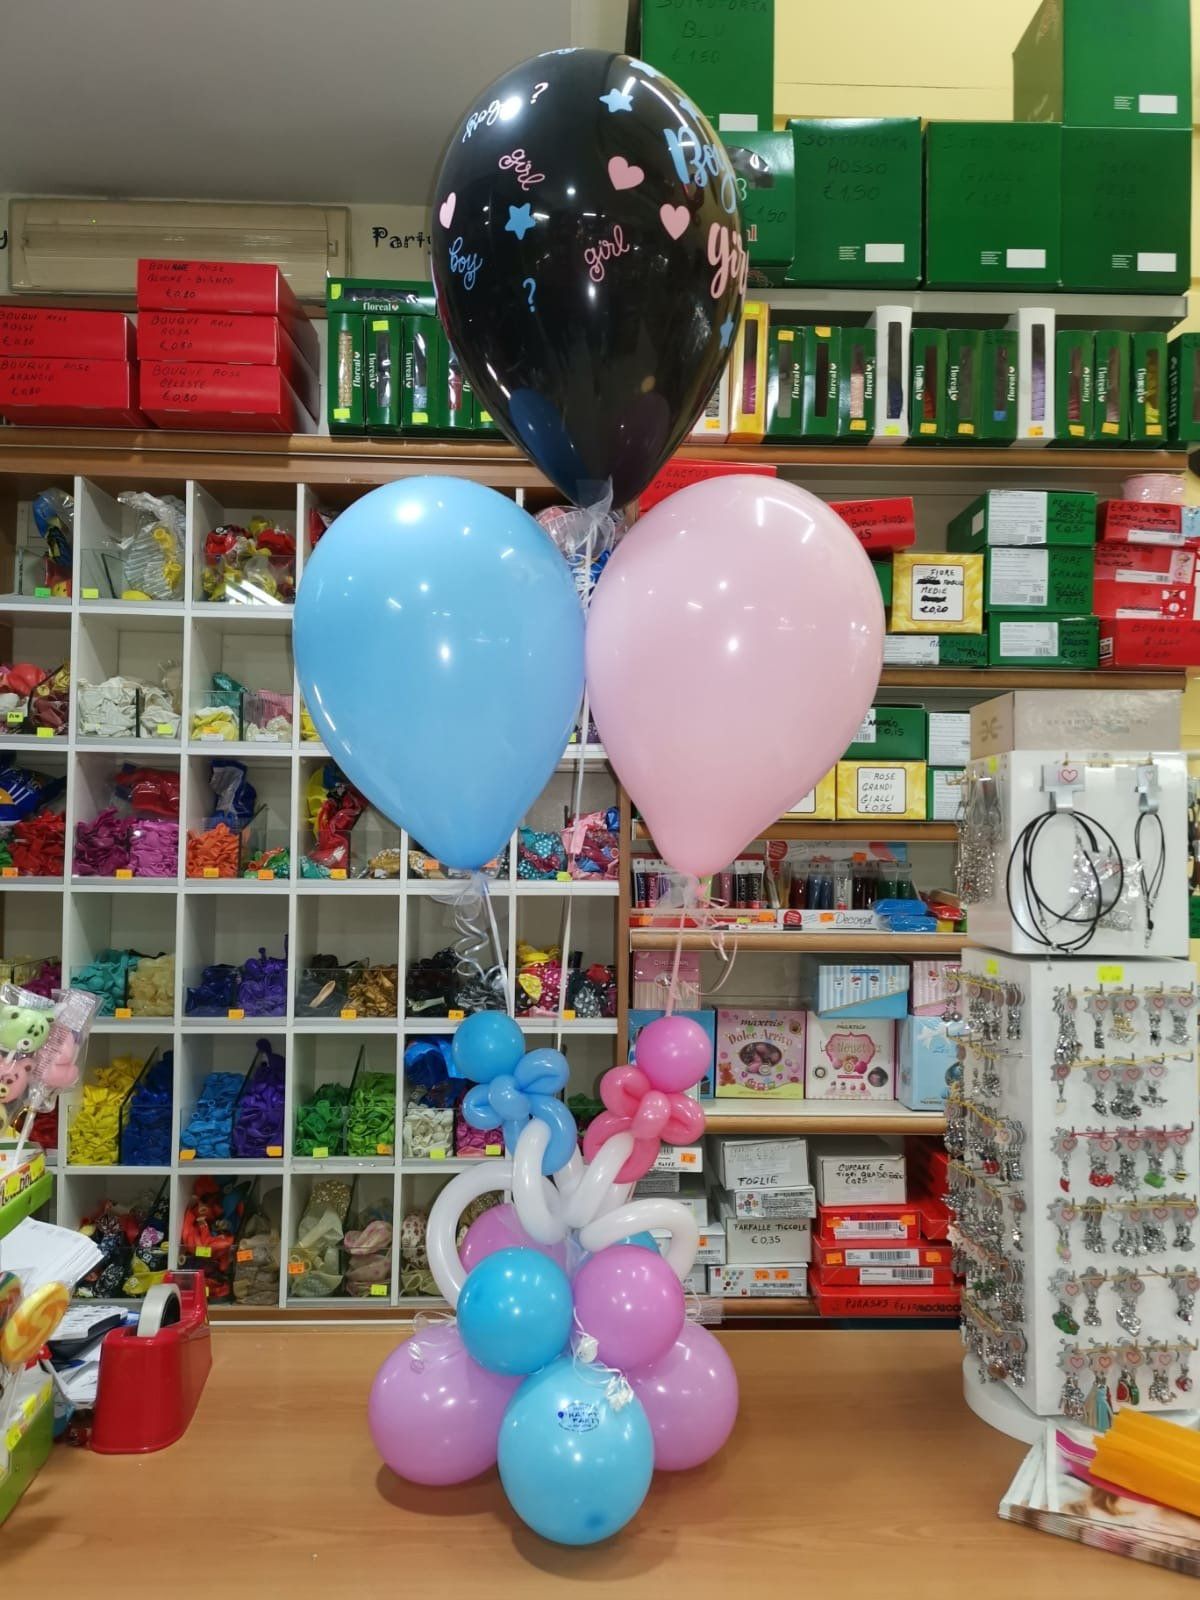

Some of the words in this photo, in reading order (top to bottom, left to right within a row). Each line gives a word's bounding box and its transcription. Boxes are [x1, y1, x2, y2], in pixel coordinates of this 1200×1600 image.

[584, 224, 630, 283] girl
[449, 236, 483, 290] boy
[522, 277, 537, 312] ?
[363, 302, 391, 312] floreal
[792, 370, 800, 398] floreal
[828, 370, 837, 398] floreal
[865, 371, 873, 399] floreal
[930, 568, 955, 577] FIORE
[873, 772, 896, 781] ROSE
[861, 782, 893, 792] GRANDI
[860, 793, 895, 804] GIALLI
[727, 1029, 758, 1046] Dolce
[760, 1029, 793, 1047] Arrivo
[737, 1175, 779, 1187] FOGLIE
